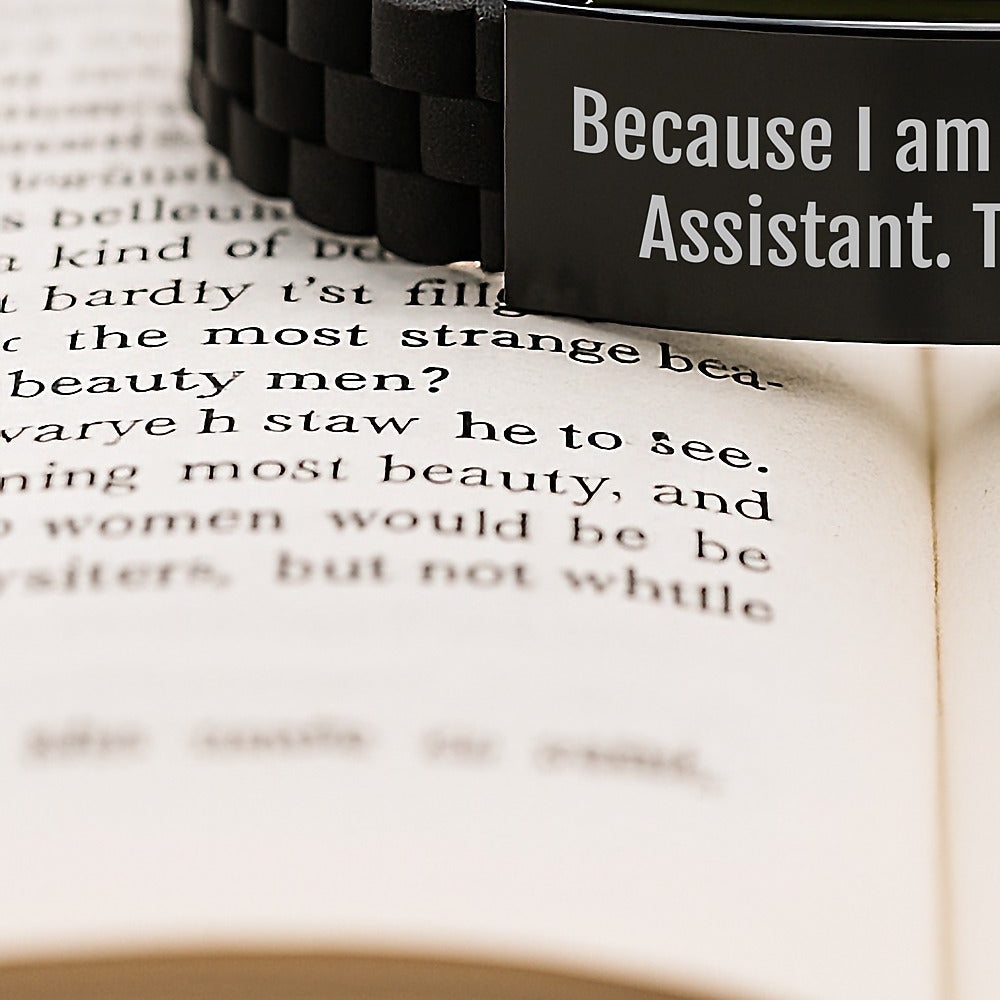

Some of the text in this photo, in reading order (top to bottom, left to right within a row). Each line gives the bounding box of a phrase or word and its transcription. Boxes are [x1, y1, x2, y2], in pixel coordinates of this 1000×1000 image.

[574, 87, 831, 171] Because
[859, 107, 870, 171] I
[896, 119, 989, 172] am
[53, 235, 191, 268] kind
[226, 227, 292, 258] of
[639, 194, 950, 268] Assistant.
[8, 367, 449, 398] beauty men?
[68, 325, 168, 350] the
[201, 324, 368, 346] most
[402, 324, 641, 364] strange
[658, 341, 784, 391] bea-
[264, 410, 419, 434] staw
[455, 411, 537, 445] he
[559, 424, 622, 450] to
[651, 432, 768, 473] see.
[183, 457, 342, 481] most
[379, 454, 621, 506] beauty,
[654, 485, 773, 521] and
[46, 511, 283, 537] women
[332, 510, 528, 539] would
[573, 517, 645, 545] be
[697, 530, 769, 570] be
[276, 551, 385, 583] but
[422, 561, 527, 587] not
